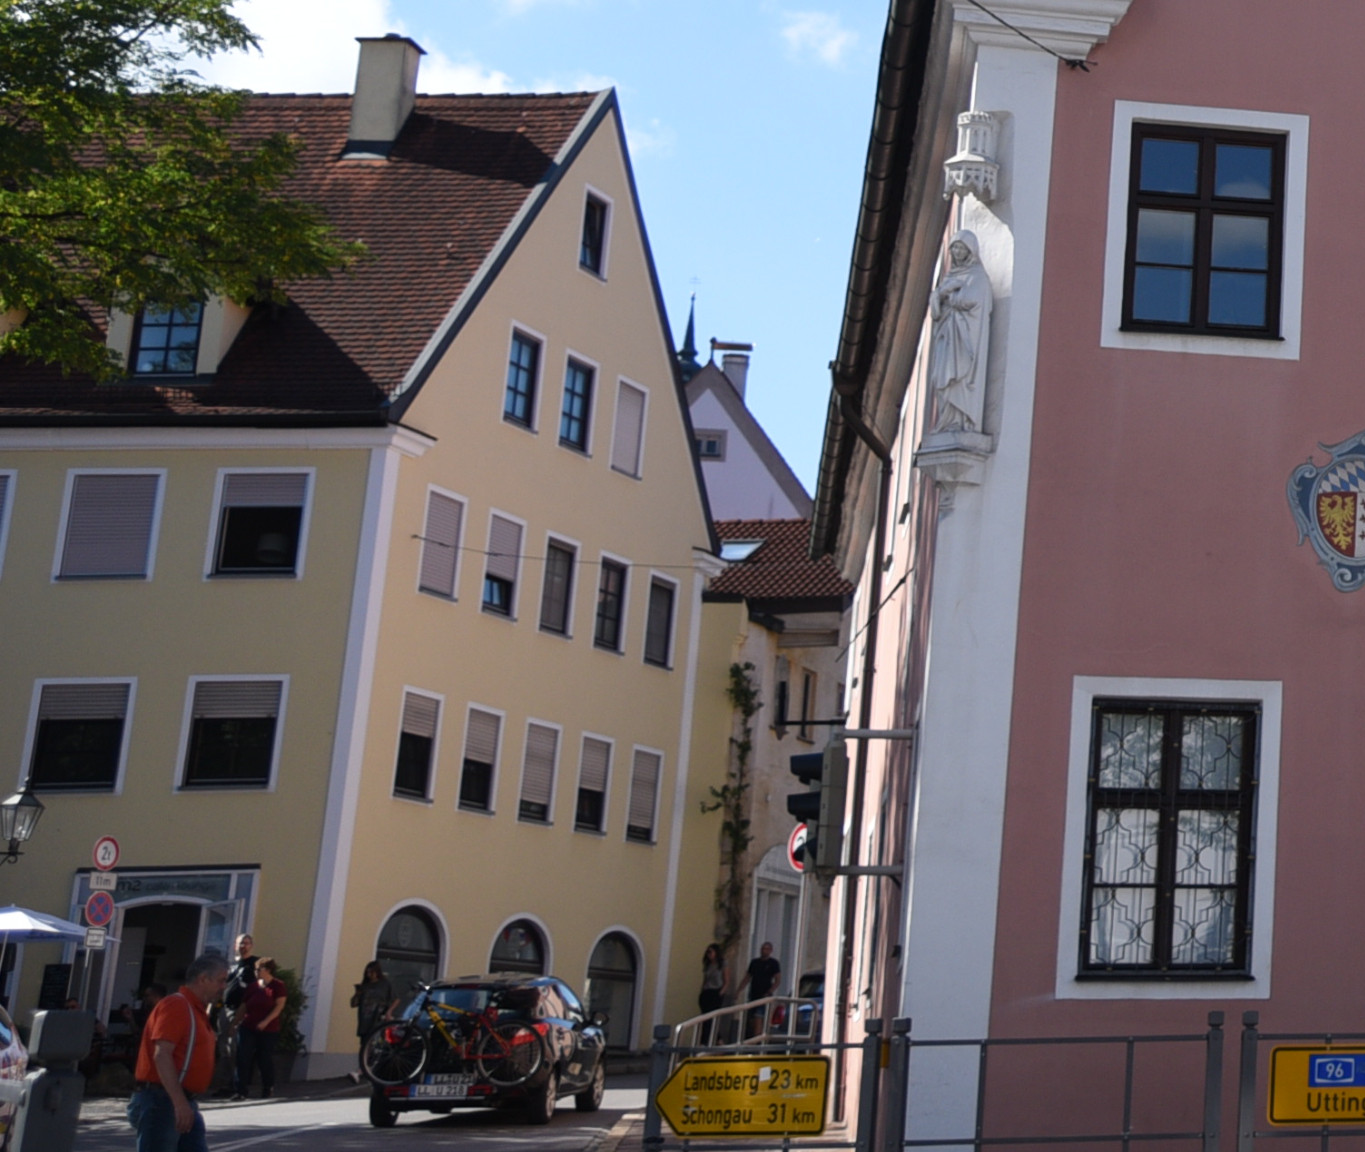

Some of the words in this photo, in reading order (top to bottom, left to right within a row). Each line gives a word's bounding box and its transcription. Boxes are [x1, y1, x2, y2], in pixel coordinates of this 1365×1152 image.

[684, 1070, 759, 1095] Landsberg
[768, 1069, 792, 1091] 23
[795, 1075, 818, 1090] km
[1326, 1063, 1344, 1078] 96
[682, 1104, 753, 1129] Schongau
[767, 1103, 786, 1124] 31
[792, 1108, 815, 1123] km
